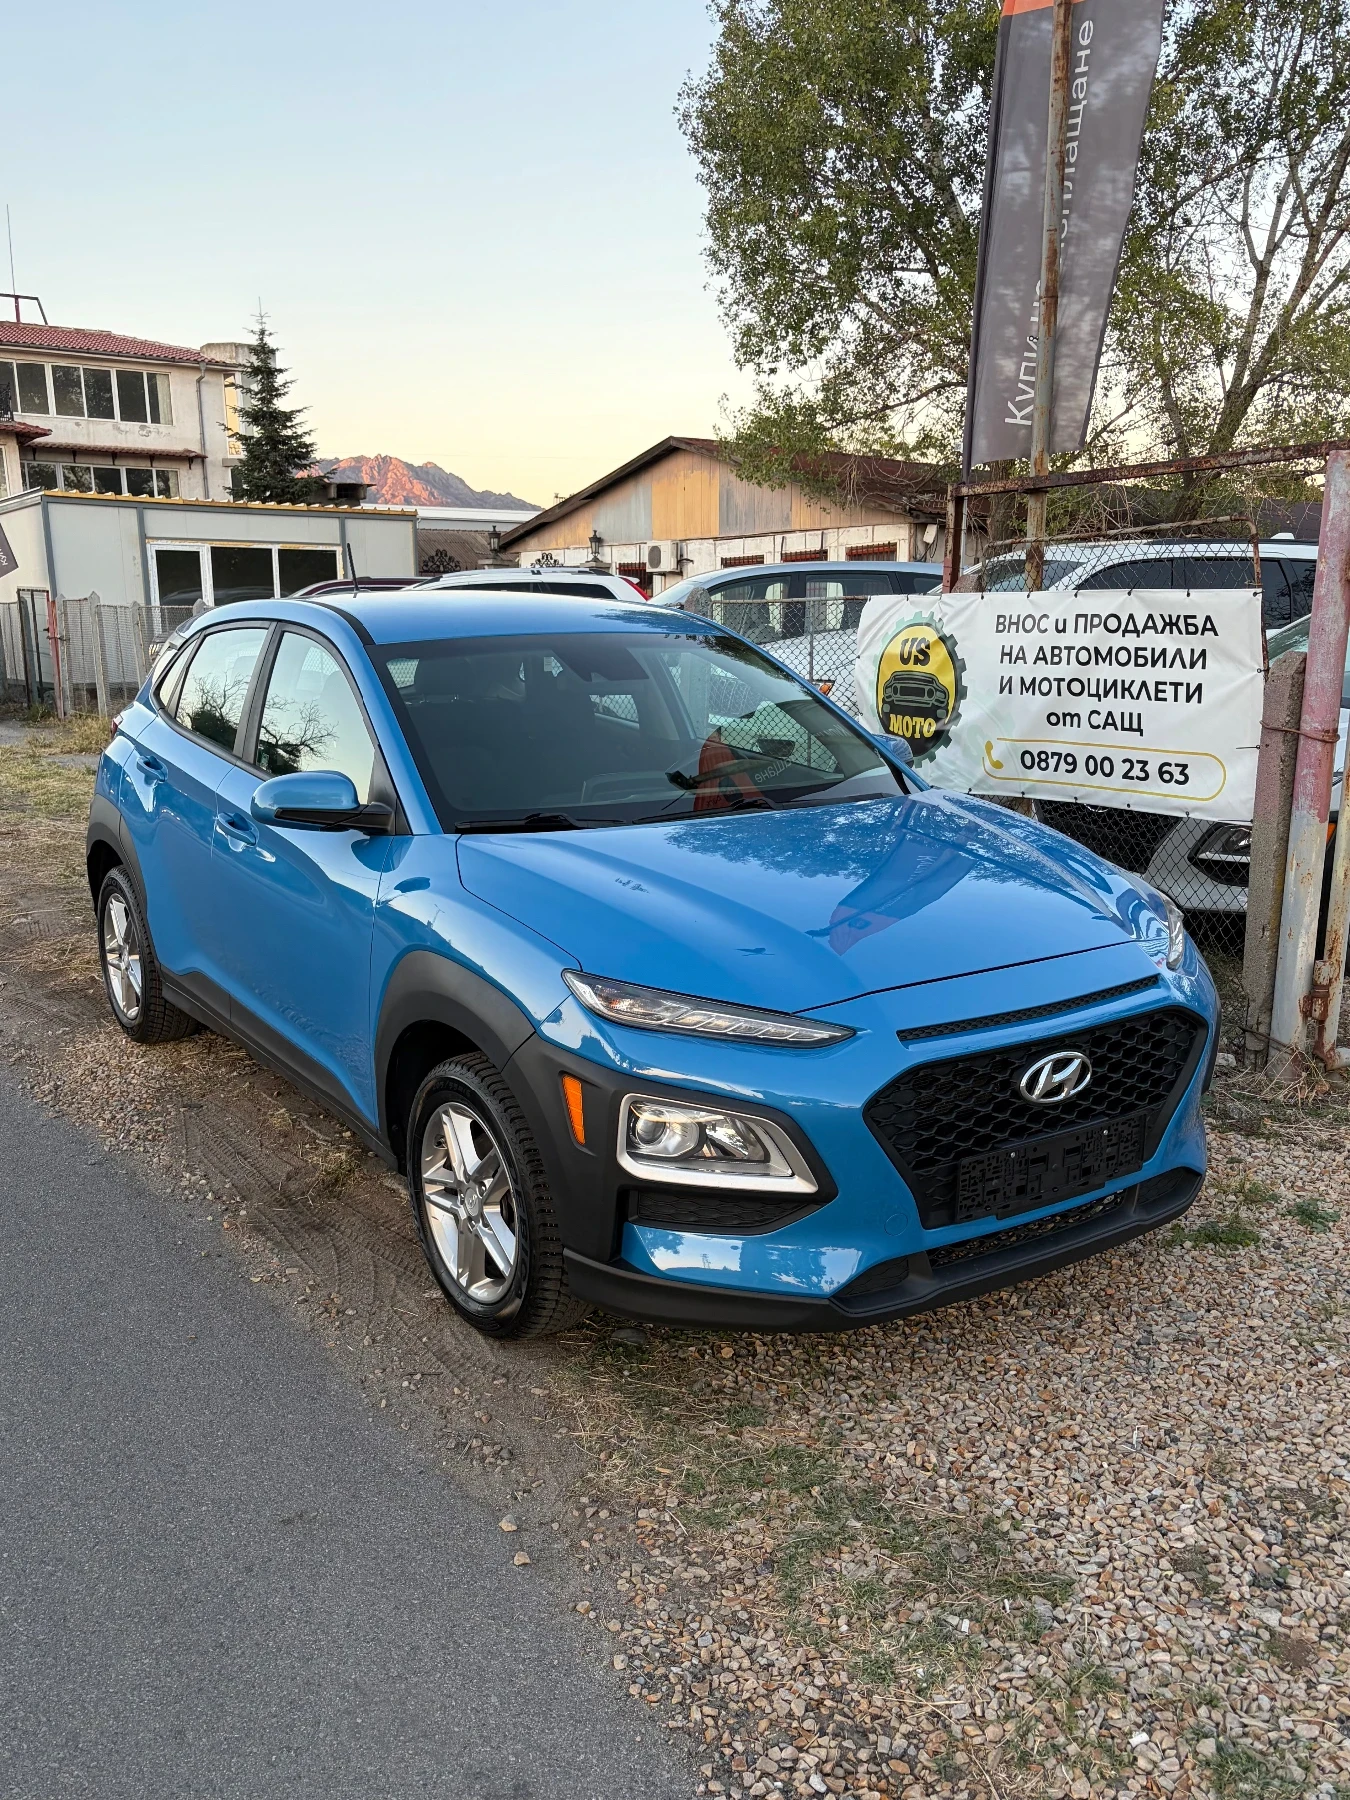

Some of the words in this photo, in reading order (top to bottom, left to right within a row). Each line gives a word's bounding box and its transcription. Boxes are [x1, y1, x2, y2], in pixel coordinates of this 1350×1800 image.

[995, 613, 1050, 634] ВНОС
[1073, 613, 1220, 639] ПРОДАЖБА
[900, 637, 931, 666] US
[999, 644, 1028, 665] НА
[1032, 645, 1207, 670] АВТОМОБИЛИ
[999, 675, 1013, 695] И
[1019, 676, 1203, 704] МОТОЦИКЛЕТИ
[889, 713, 937, 739] MOTO
[1087, 709, 1144, 737] САЩ
[1020, 749, 1078, 774] 0879
[1084, 754, 1115, 778] 00
[1121, 757, 1150, 782] 23
[1157, 761, 1190, 786] 63
